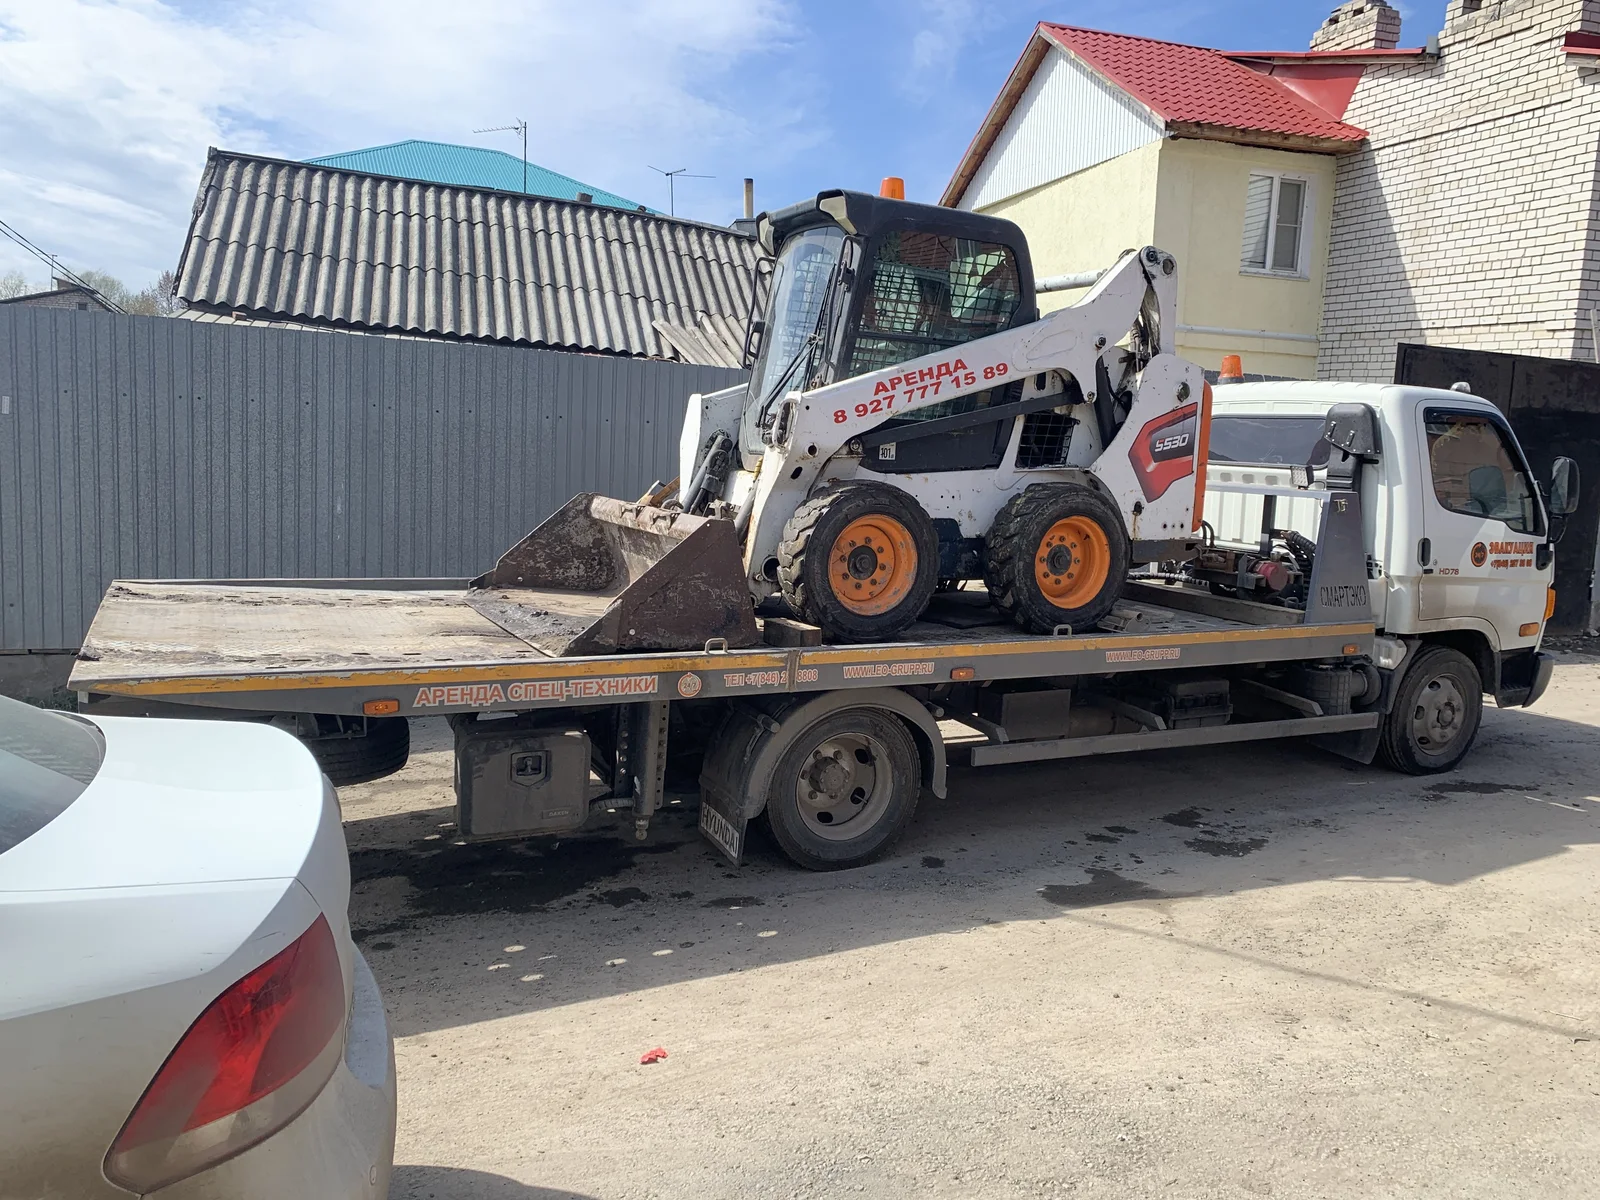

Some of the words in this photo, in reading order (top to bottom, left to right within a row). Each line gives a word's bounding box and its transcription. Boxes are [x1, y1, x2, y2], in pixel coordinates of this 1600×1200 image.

[873, 358, 969, 396] АРЕНДА
[833, 409, 848, 424] 8
[854, 394, 896, 418] 927
[903, 381, 942, 403] 777
[951, 371, 976, 389] 15
[982, 362, 1009, 380] 89
[1154, 433, 1190, 452] S530
[1320, 585, 1367, 608] СМАРТЭКО
[413, 683, 507, 707] АРЕНДА
[508, 676, 658, 702] СПЕЦ-ТЕХНИКИ
[724, 673, 745, 687] ТЕЛ
[746, 671, 779, 687] +7(846)
